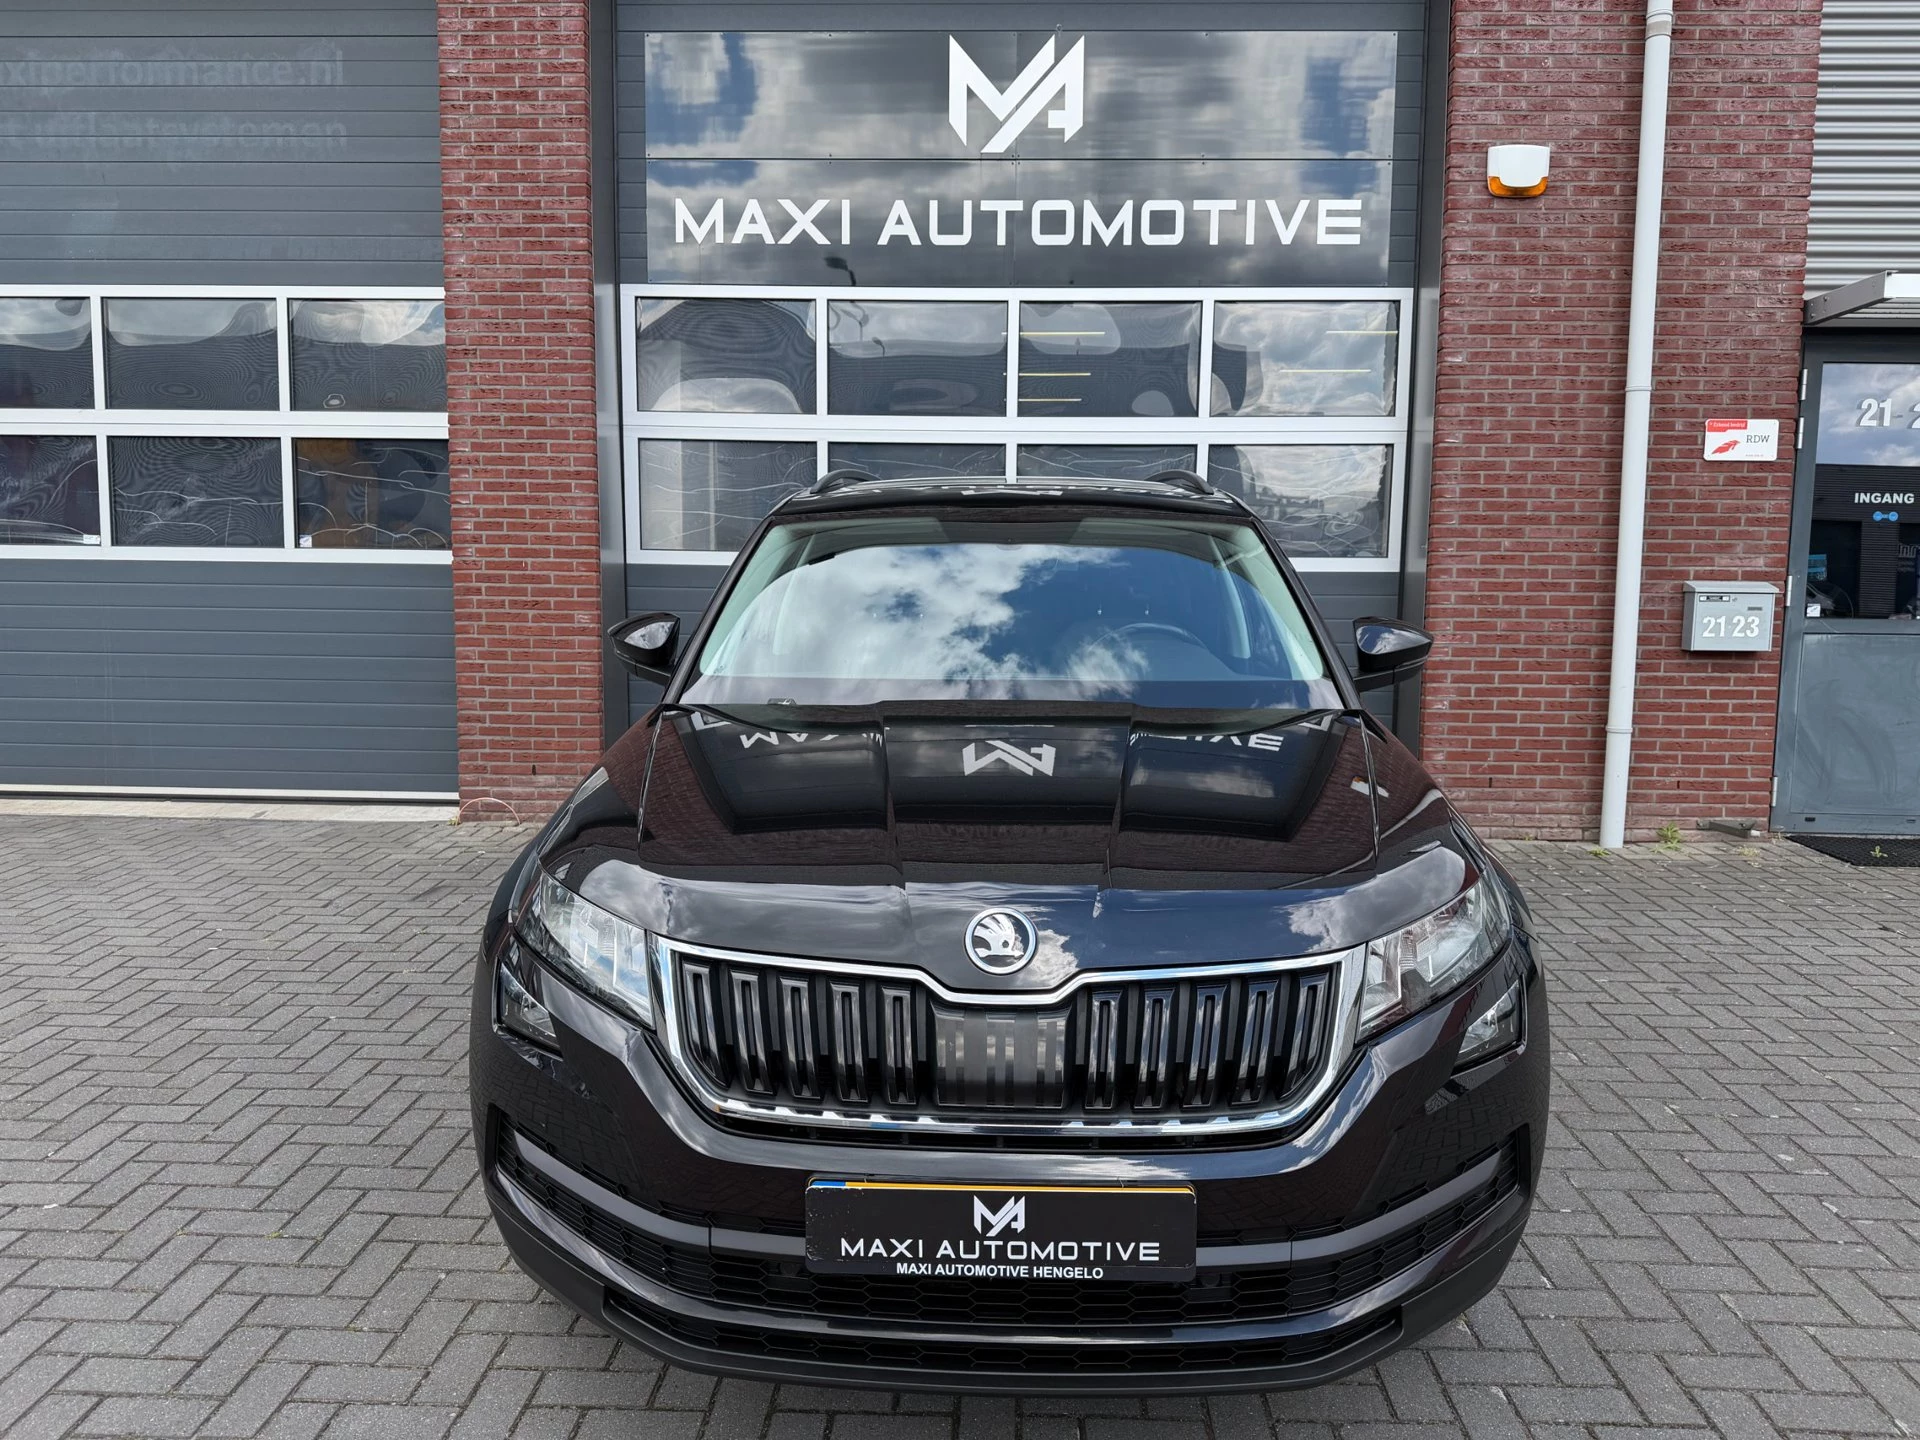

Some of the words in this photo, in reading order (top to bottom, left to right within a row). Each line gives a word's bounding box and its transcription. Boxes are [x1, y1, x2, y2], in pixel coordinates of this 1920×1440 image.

[675, 198, 851, 245] MAXI
[877, 199, 1362, 246] AUTOMOTIVE
[1746, 434, 1770, 443] RDW
[1854, 492, 1915, 504] INGANG
[840, 1237, 923, 1258] MAXI
[936, 1239, 1160, 1261] AUTOMOTIVE
[896, 1263, 932, 1275] MAXI
[934, 1264, 1029, 1278] AUTOMOTIVE
[1033, 1266, 1104, 1279] HENGELO
